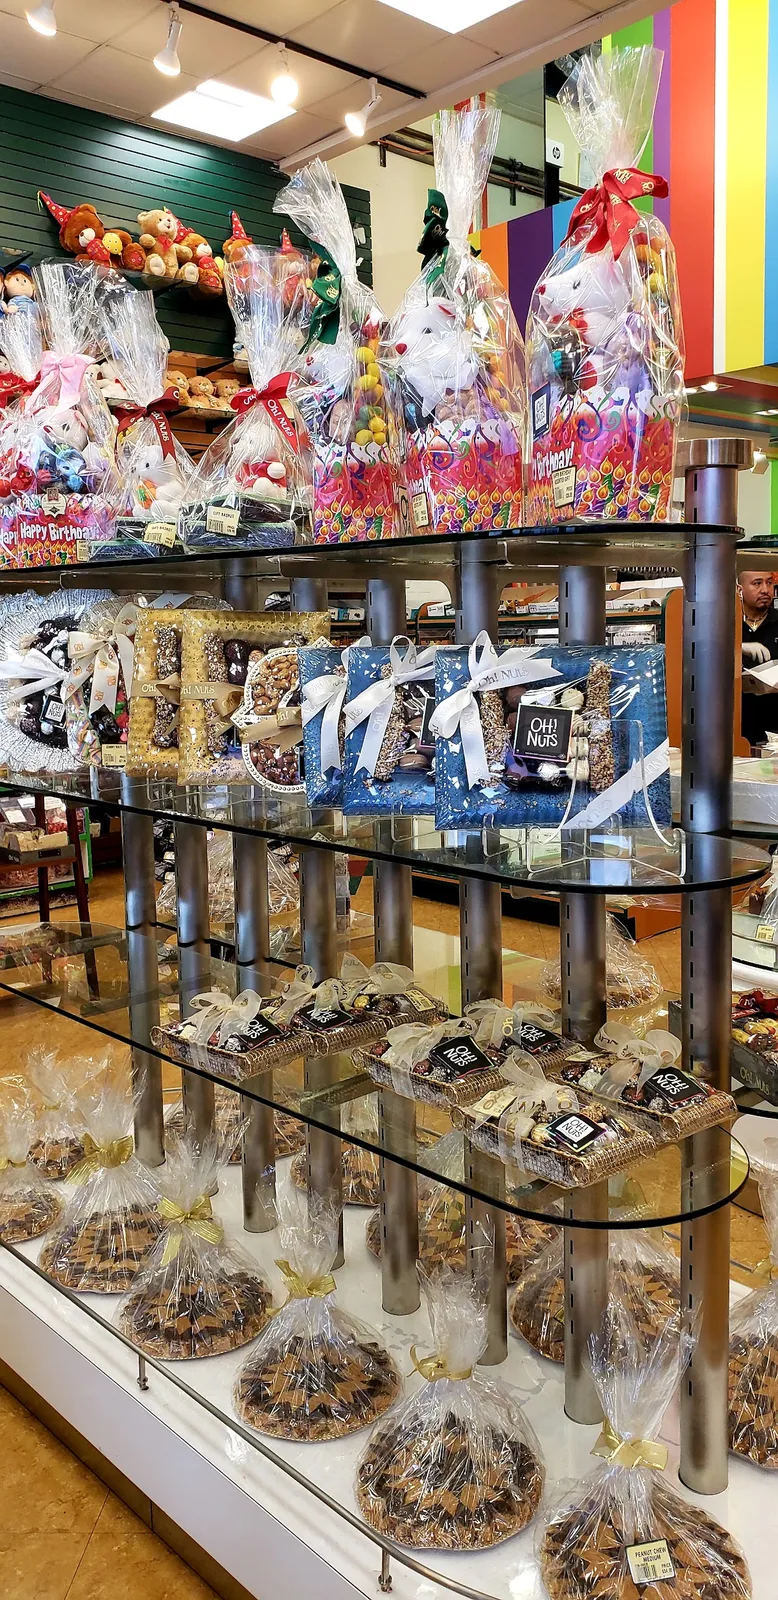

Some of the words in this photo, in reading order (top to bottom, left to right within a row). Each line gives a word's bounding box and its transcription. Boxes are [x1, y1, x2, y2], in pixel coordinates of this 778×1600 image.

[267, 399, 282, 417] Oh!
[20, 521, 47, 541] Happy
[479, 673, 498, 686] Oh!
[530, 718, 557, 733] OH!
[527, 730, 558, 748] NUTS
[524, 1024, 546, 1038] OH!
[443, 1048, 469, 1067] NUTS
[456, 1046, 478, 1062] OH!
[652, 1074, 680, 1095] NUTS
[664, 1073, 690, 1090] OH!
[561, 1123, 583, 1138] NUTS
[569, 1119, 589, 1133] OH!
[635, 1550, 653, 1558] PEANUT
[642, 1554, 662, 1562] MEDIUM
